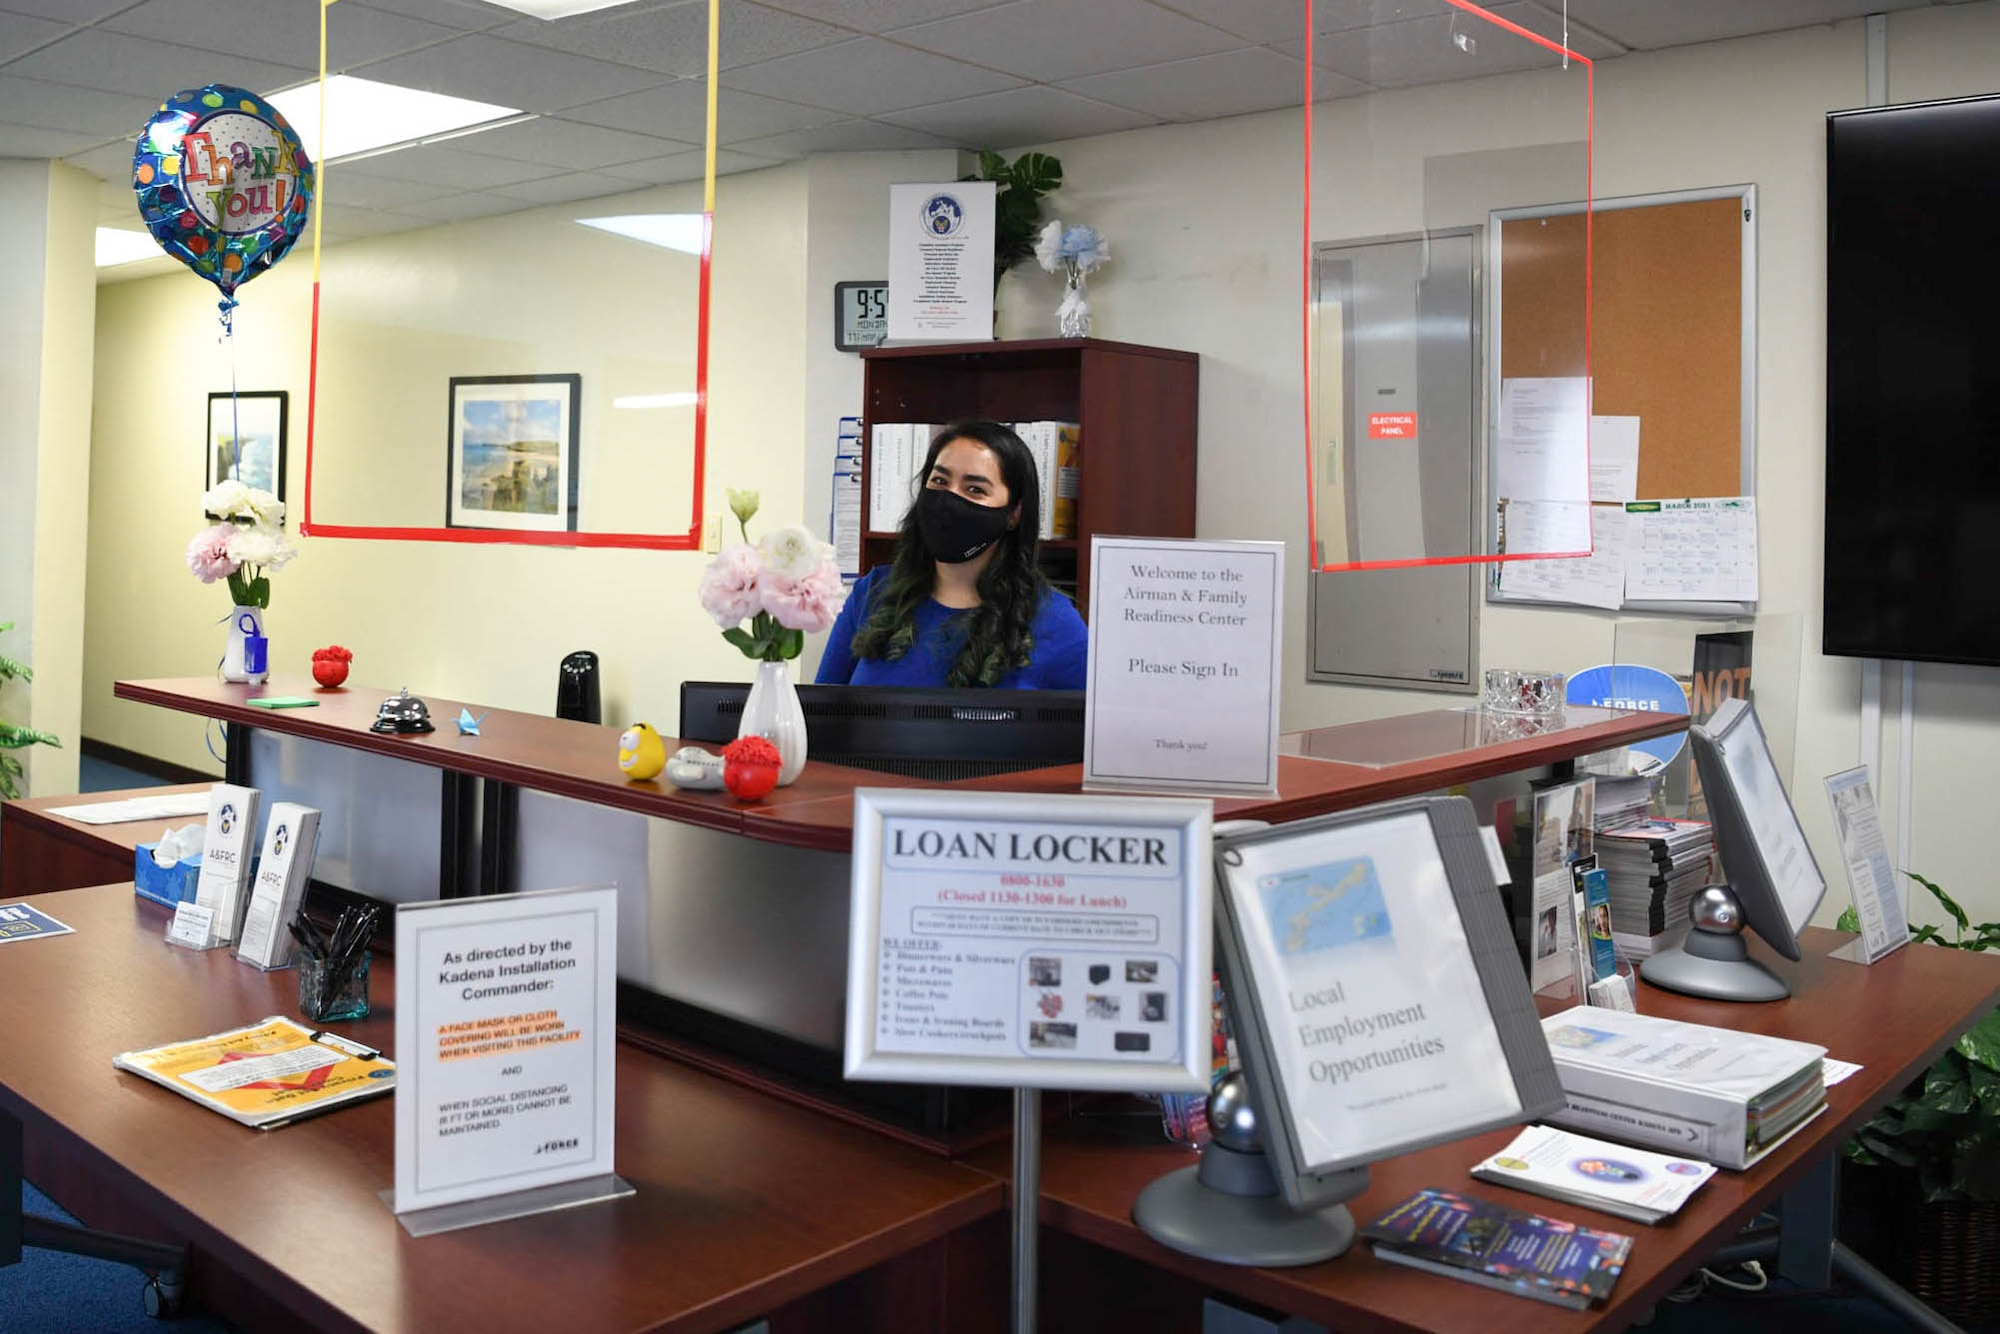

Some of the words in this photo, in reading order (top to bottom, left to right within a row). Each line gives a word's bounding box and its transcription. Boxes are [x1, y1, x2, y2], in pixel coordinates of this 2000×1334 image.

[206, 180, 285, 231] you!
[857, 289, 889, 319] 9:5
[1371, 416, 1414, 425] ELECTRICAL
[1380, 427, 1404, 435] PANEL
[1693, 502, 1711, 510] 2021
[1131, 564, 1197, 580] Welcome
[1200, 570, 1216, 581] to
[1220, 567, 1244, 582] the
[1124, 586, 1177, 601] Airman
[1182, 588, 1193, 602] &
[1198, 588, 1247, 608] Family
[1124, 607, 1194, 623] Readiness
[1198, 610, 1247, 626] Center
[1128, 658, 1177, 674] Please
[1181, 660, 1216, 680] Sign
[1222, 662, 1239, 677] In
[1694, 668, 1751, 715] NOT
[1152, 738, 1185, 750] Thank
[209, 848, 236, 864] A&FRC
[894, 829, 997, 860] LOAN
[1010, 832, 1169, 866] LOCKER
[1000, 875, 1066, 888] 0800-1630
[938, 889, 986, 904] (Closed
[1057, 893, 1076, 906] for
[1080, 894, 1128, 909] Lunch)
[443, 952, 462, 965] As
[466, 943, 526, 962] directed
[529, 942, 547, 957] by
[549, 938, 573, 952] the
[439, 968, 495, 984] Kadena
[499, 957, 577, 977] Installation
[462, 979, 554, 1000] Commander:
[1288, 980, 1346, 1013] Local
[439, 1031, 492, 1046] COVERING
[494, 1027, 516, 1039] WILL
[519, 1025, 533, 1036] BE
[535, 1020, 565, 1033] WORN
[440, 1024, 448, 1034] A
[449, 1021, 475, 1033] FACE
[477, 1018, 505, 1028] MASK
[508, 1015, 523, 1025] OR
[525, 1010, 557, 1022] CLOTH
[1298, 1002, 1427, 1048] Employment
[440, 1047, 470, 1059] WHEN
[472, 1039, 514, 1054] VISITING
[517, 1035, 538, 1048] THIS
[540, 1030, 581, 1044] FACILITY
[501, 1064, 523, 1077] AND
[1308, 1034, 1447, 1085] Opportunities
[439, 1099, 470, 1113] WHEN
[472, 1093, 508, 1108] SOCIAL
[510, 1083, 569, 1102] DISTANCING
[464, 1109, 480, 1121] OR
[481, 1104, 515, 1118] MORE)
[516, 1097, 556, 1113] CANNOT
[559, 1094, 573, 1106] BE
